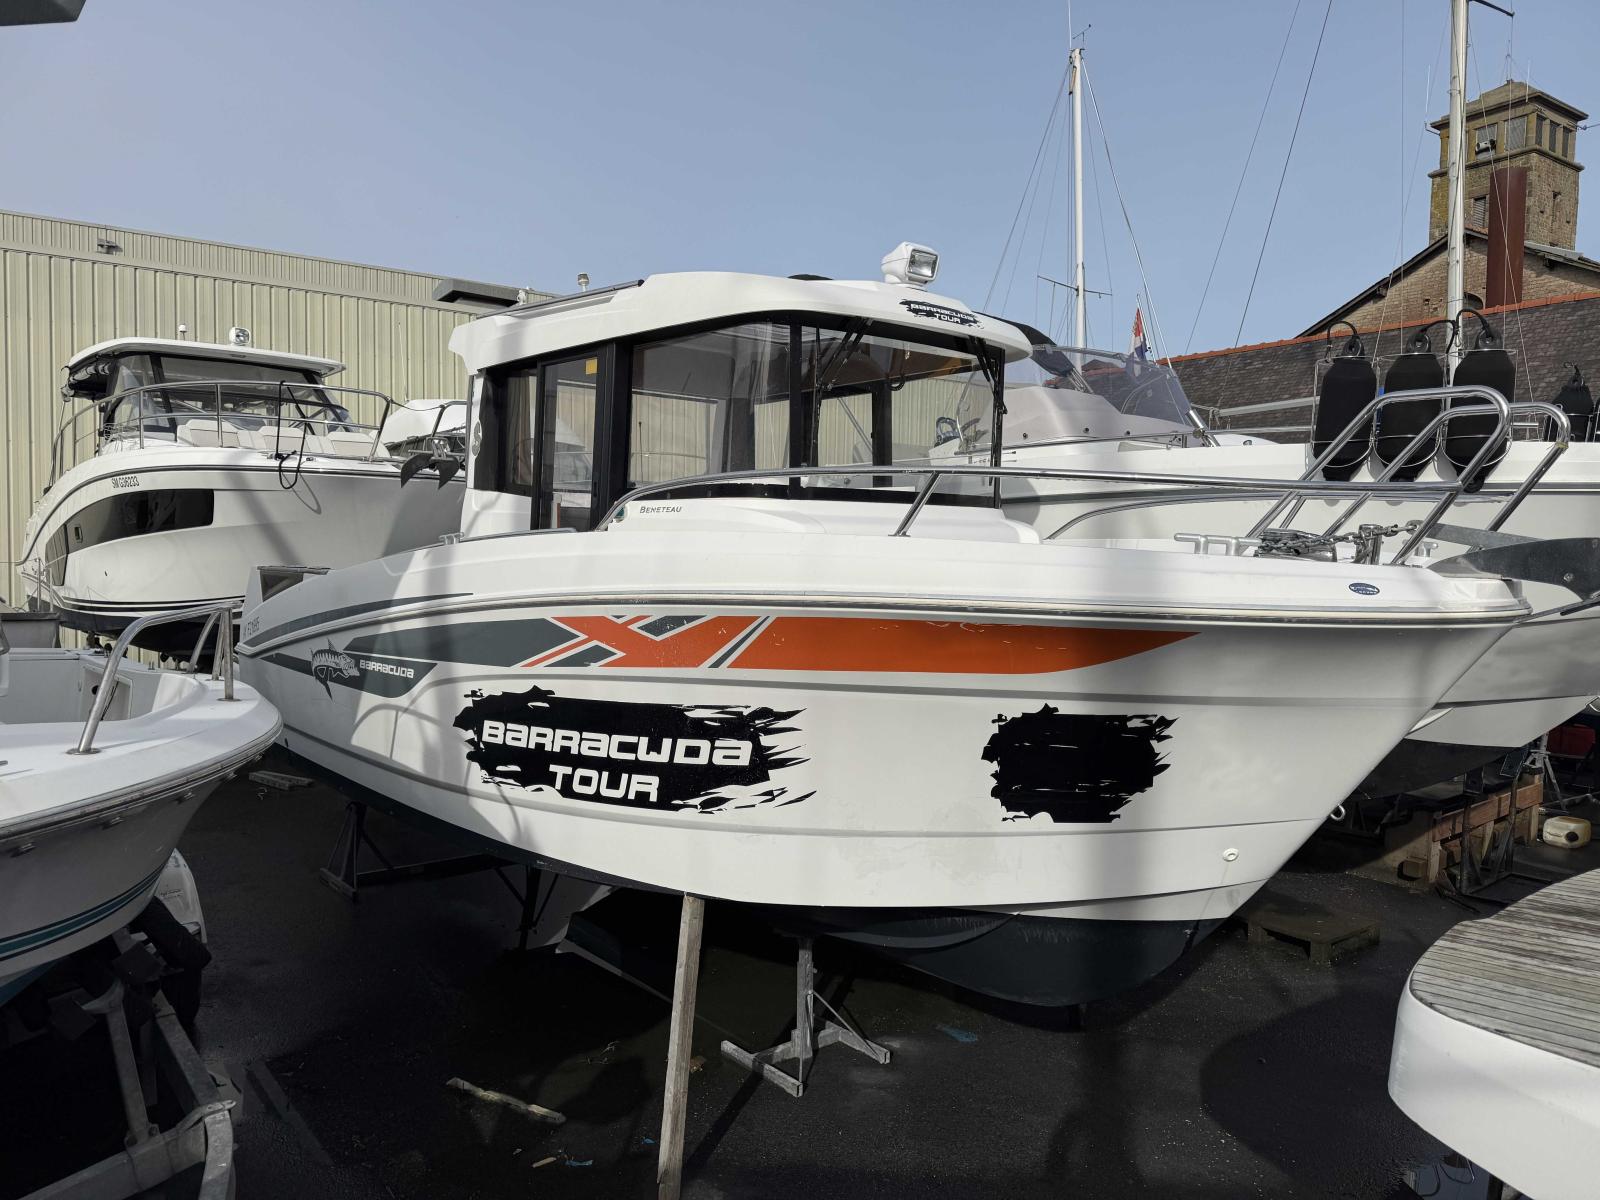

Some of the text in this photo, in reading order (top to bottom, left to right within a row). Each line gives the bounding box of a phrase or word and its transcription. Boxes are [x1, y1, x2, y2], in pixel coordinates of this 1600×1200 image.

[934, 313, 961, 323] TOUR
[639, 506, 682, 514] BENETEAU
[549, 765, 660, 802] TOUR
